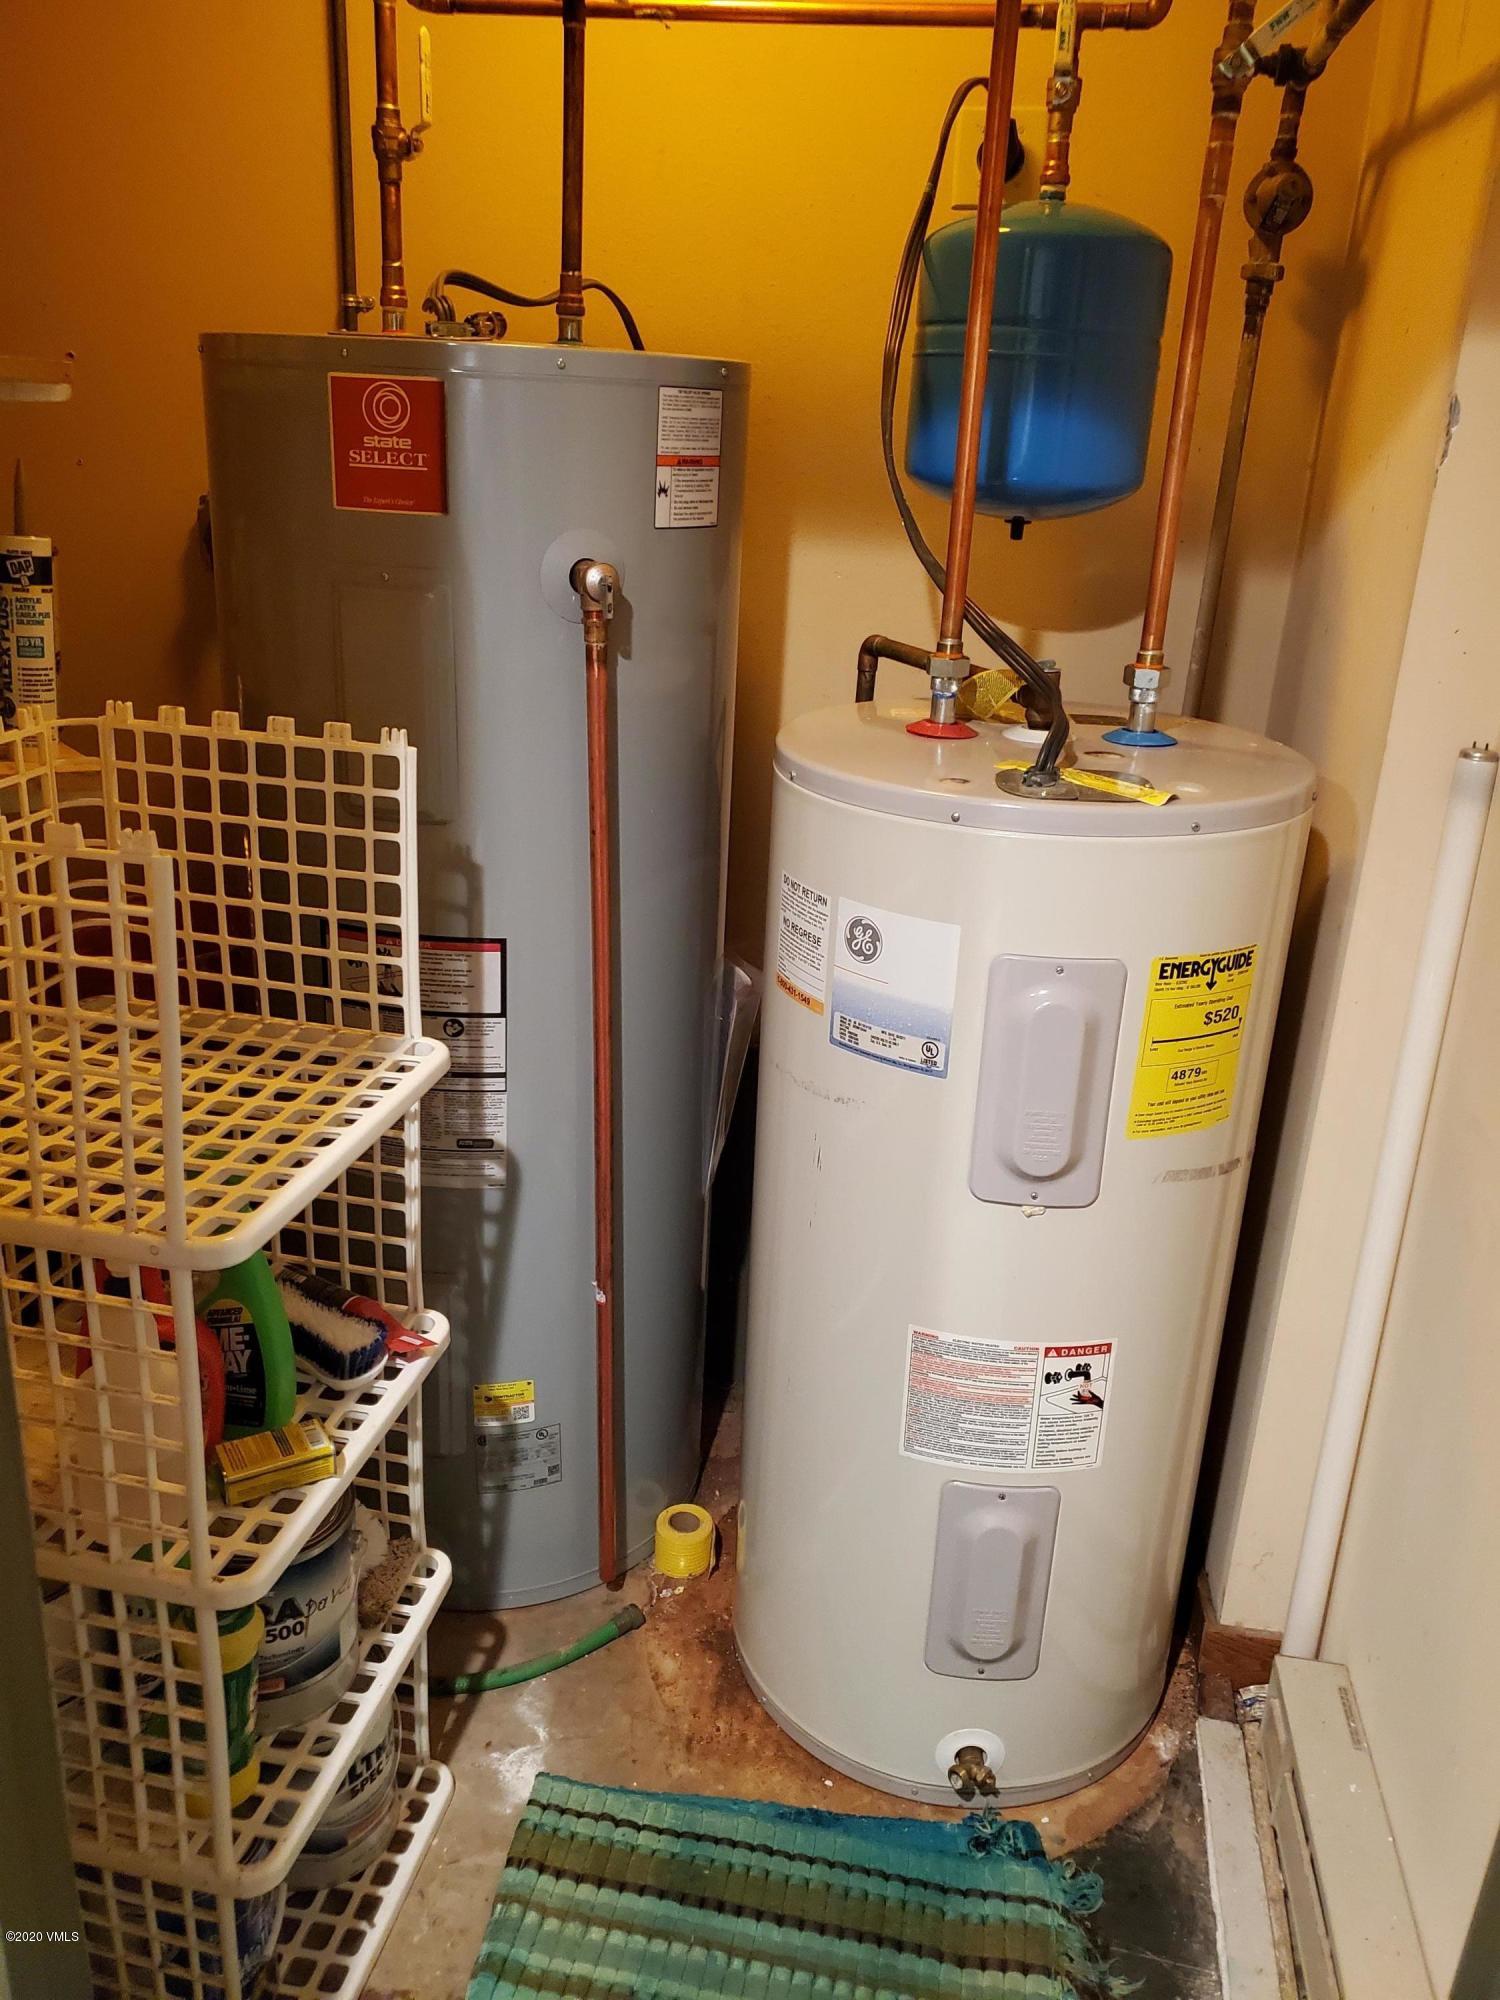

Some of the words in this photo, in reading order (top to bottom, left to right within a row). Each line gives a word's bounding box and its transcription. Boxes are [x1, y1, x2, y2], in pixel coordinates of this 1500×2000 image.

[363, 435, 412, 449] state
[348, 449, 428, 467] SELECT
[9, 558, 33, 576] DAP
[783, 873, 791, 887] DO
[790, 879, 802, 894] NOT
[801, 886, 828, 908] RETURN
[783, 915, 791, 928] NO
[791, 921, 822, 947] REGRESE
[1158, 949, 1255, 983] ENERGYGUIDE
[1203, 1004, 1241, 1027] $520
[1170, 1067, 1202, 1081] 4879
[1061, 1345, 1108, 1357] DANGER
[350, 1761, 383, 1801] SPEC
